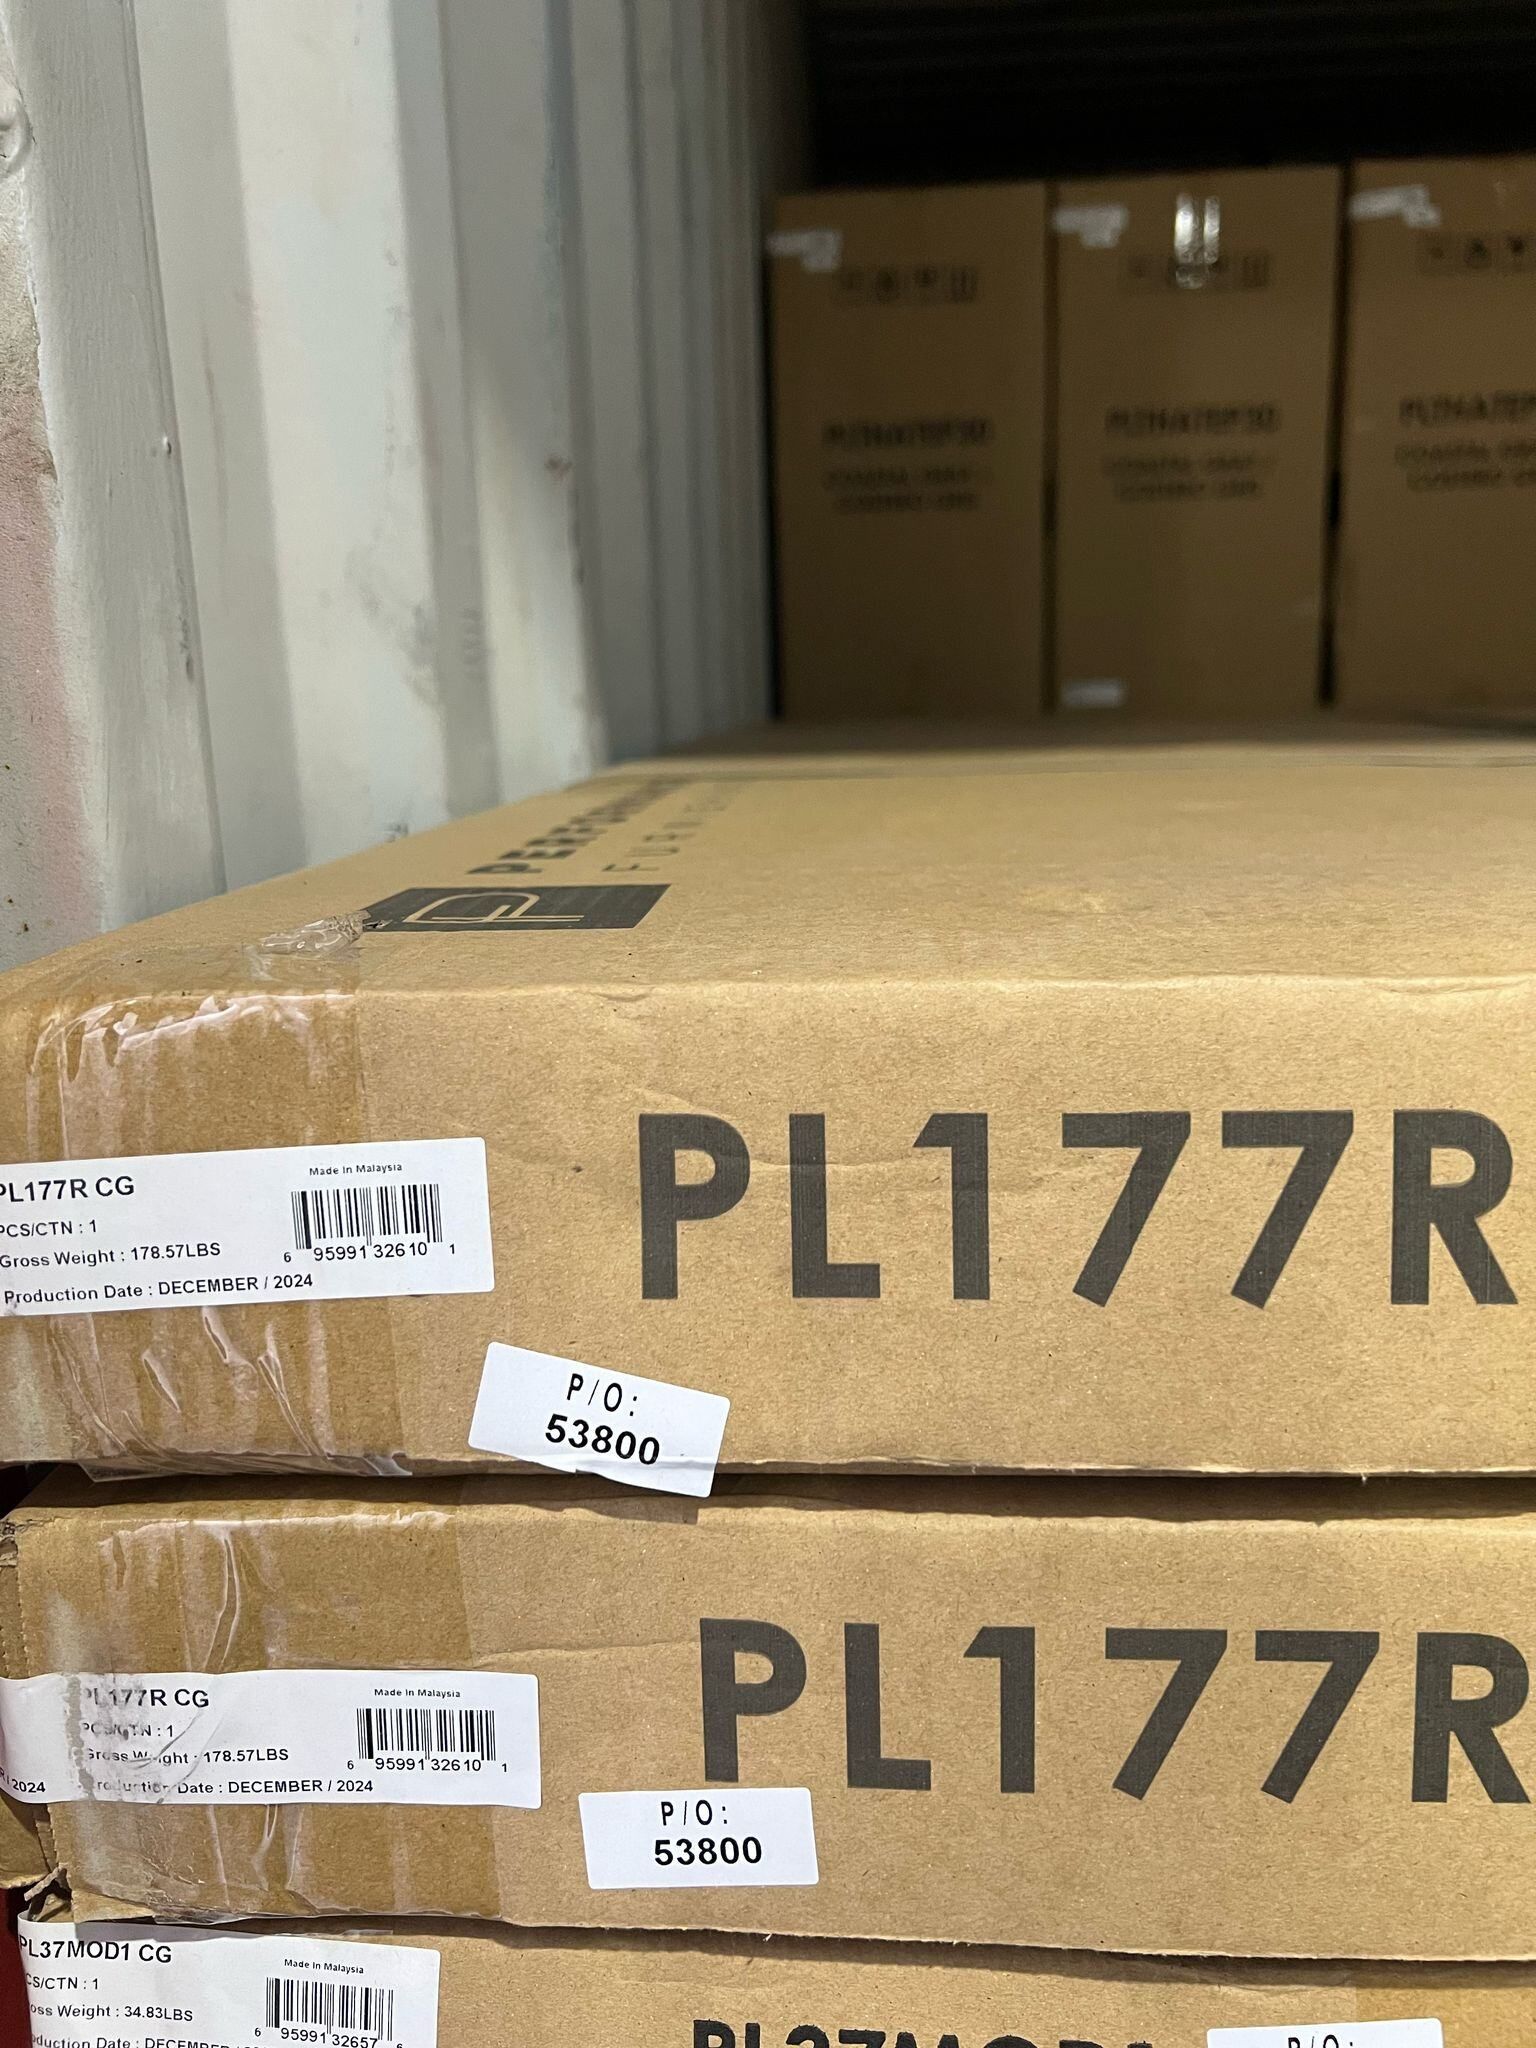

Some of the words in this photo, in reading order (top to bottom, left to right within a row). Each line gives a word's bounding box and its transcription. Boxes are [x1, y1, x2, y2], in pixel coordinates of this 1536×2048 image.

[309, 1167, 339, 1176] Made
[356, 1163, 403, 1173] Malaysia
[95, 1175, 135, 1197] CG
[638, 1109, 1518, 1310] PL177R
[89, 1219, 97, 1233] 1
[0, 1254, 50, 1268] Gross
[54, 1249, 115, 1267] Weight
[131, 1242, 221, 1260] 178.57LBS
[283, 1252, 292, 1263] 6
[449, 1243, 455, 1255] 1
[4, 1286, 98, 1304] Production
[104, 1284, 143, 1299] Date
[158, 1276, 259, 1295] DECEMBER
[273, 1273, 313, 1289] 2024
[566, 1373, 638, 1417] P/O:
[545, 1413, 660, 1466] 53800
[174, 1688, 209, 1708] CG
[374, 1688, 402, 1697] Made
[417, 1689, 461, 1699] Malaysia
[699, 1617, 1533, 1804] PL177R
[166, 1724, 173, 1737] 1
[132, 1750, 188, 1767] Wght
[203, 1748, 289, 1763] 178.57LBS
[347, 1760, 354, 1770] 6
[501, 1763, 508, 1773] 1
[11, 1778, 46, 1794] 2024
[177, 1782, 214, 1794] Date
[228, 1780, 323, 1793] DECEMBER
[337, 1780, 374, 1792] 2024
[660, 1799, 728, 1826] P/O:
[654, 1836, 762, 1866] 53800
[19, 1934, 130, 1961] PL37MOD1
[138, 1944, 172, 1964] CG
[284, 1958, 310, 1969] Made
[323, 1962, 364, 1975] Malaysia
[92, 1978, 98, 1990] 1
[57, 2004, 111, 2020] Weight
[124, 2006, 193, 2022] 34.83LBS
[255, 2027, 262, 2037] 6
[97, 2037, 131, 2048] Date
